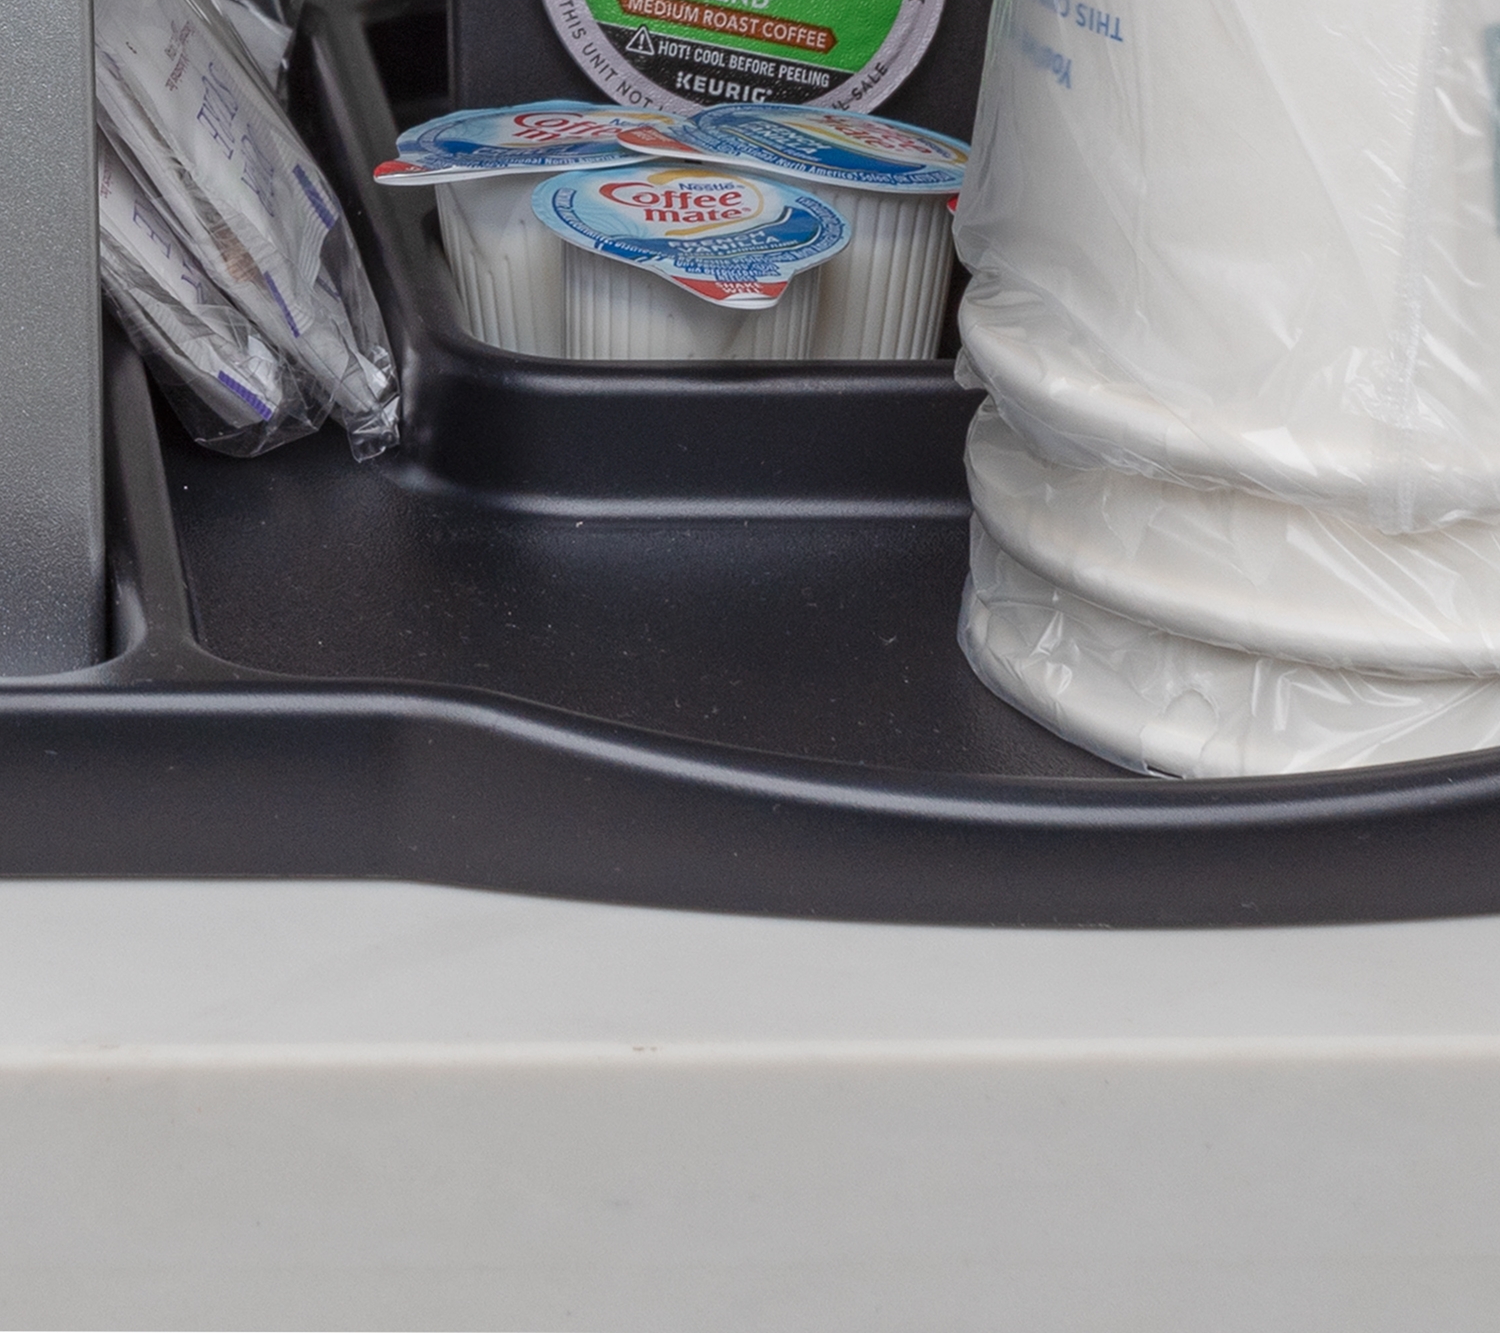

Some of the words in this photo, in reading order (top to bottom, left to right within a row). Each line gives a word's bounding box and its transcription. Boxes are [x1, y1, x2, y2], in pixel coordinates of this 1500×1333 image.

[702, 9, 758, 35] ROAST
[761, 19, 828, 50] COFFEE
[1075, 2, 1124, 43] THIS
[581, 41, 619, 81] UNIT
[615, 80, 654, 109] NOT
[657, 40, 692, 61] HOT!
[693, 47, 727, 68] COOL
[728, 54, 776, 79] BEFORE
[777, 64, 831, 90] PEELING
[850, 60, 889, 102] SALE
[675, 70, 767, 103] KEURIG
[599, 181, 743, 210] Coffee
[668, 229, 766, 250] FRENCH
[676, 234, 782, 256] VANILLA
